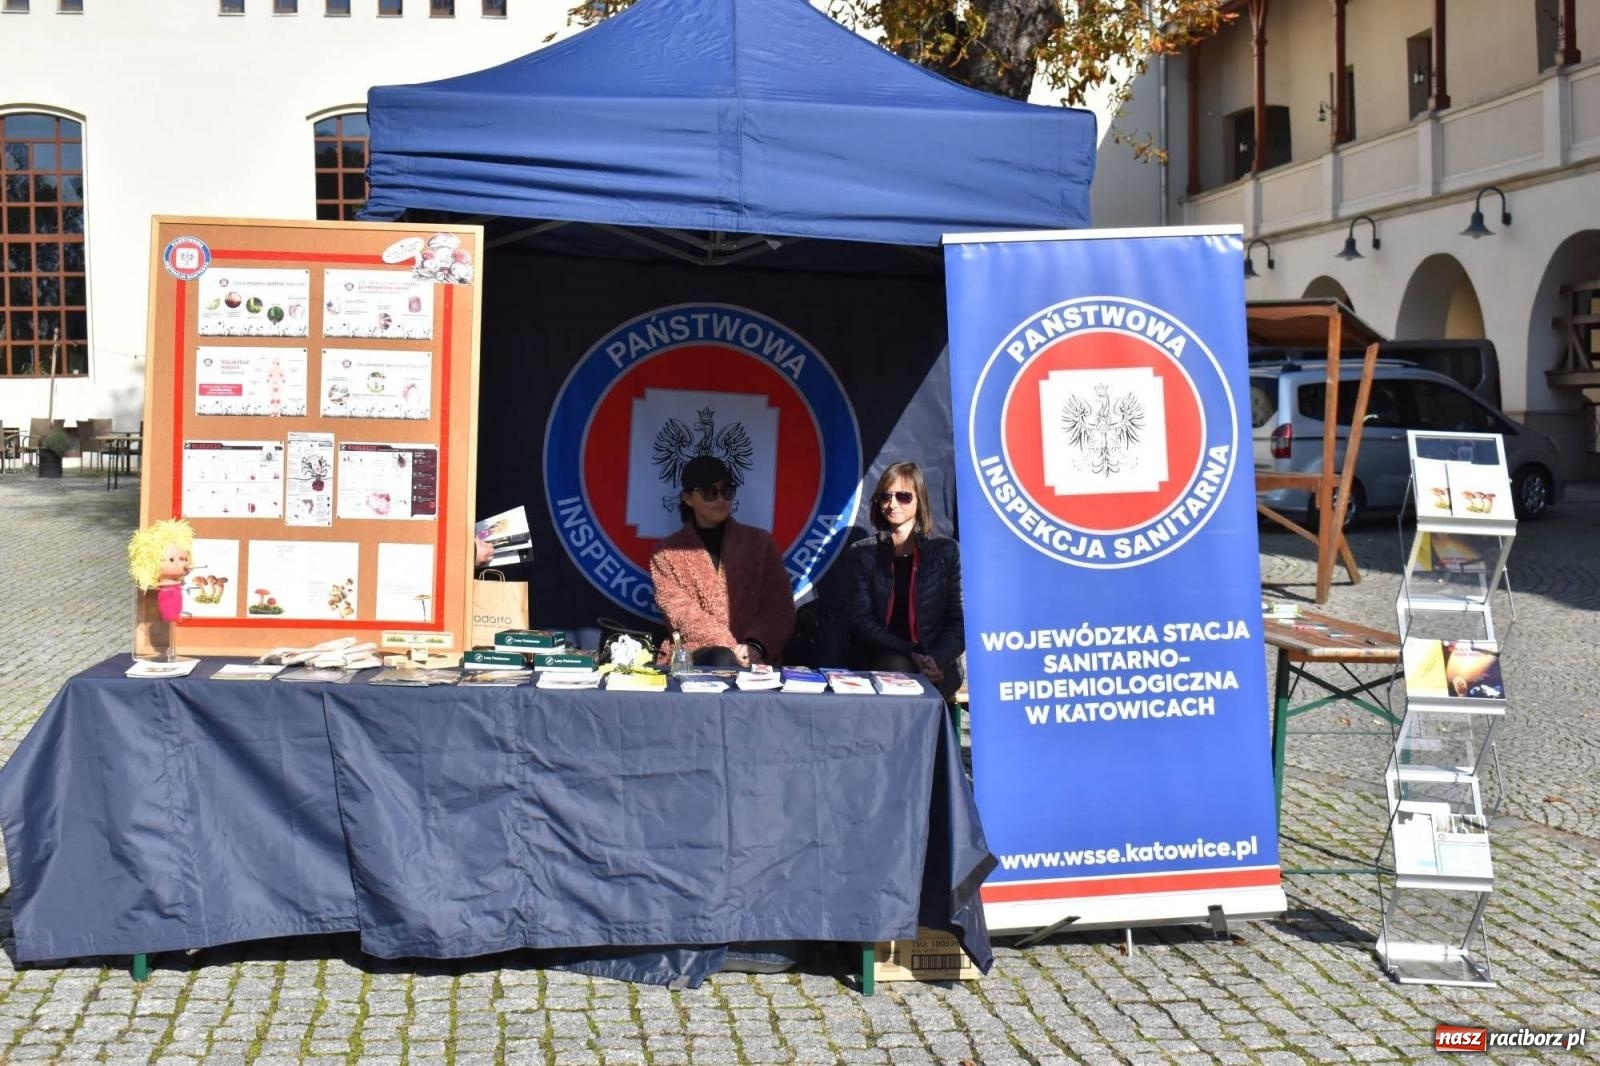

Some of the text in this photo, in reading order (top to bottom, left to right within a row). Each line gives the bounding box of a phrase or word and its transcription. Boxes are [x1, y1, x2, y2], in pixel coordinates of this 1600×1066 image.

[605, 312, 808, 381] PAŃSTWOWA
[1006, 305, 1187, 363] PAŃSTWOWA
[980, 444, 1230, 559] INSPEKCJA SANITARNA
[557, 496, 660, 614] INSPEKC
[981, 620, 1250, 651] WOJEWÓDZKA STACJA
[1043, 649, 1190, 673] SANITARNO-
[999, 671, 1239, 701] EPIDEMIOLOGICZNA
[1025, 697, 1215, 725] W KATOWICACH
[1000, 836, 1258, 870] www.wsse.katowice.pl
